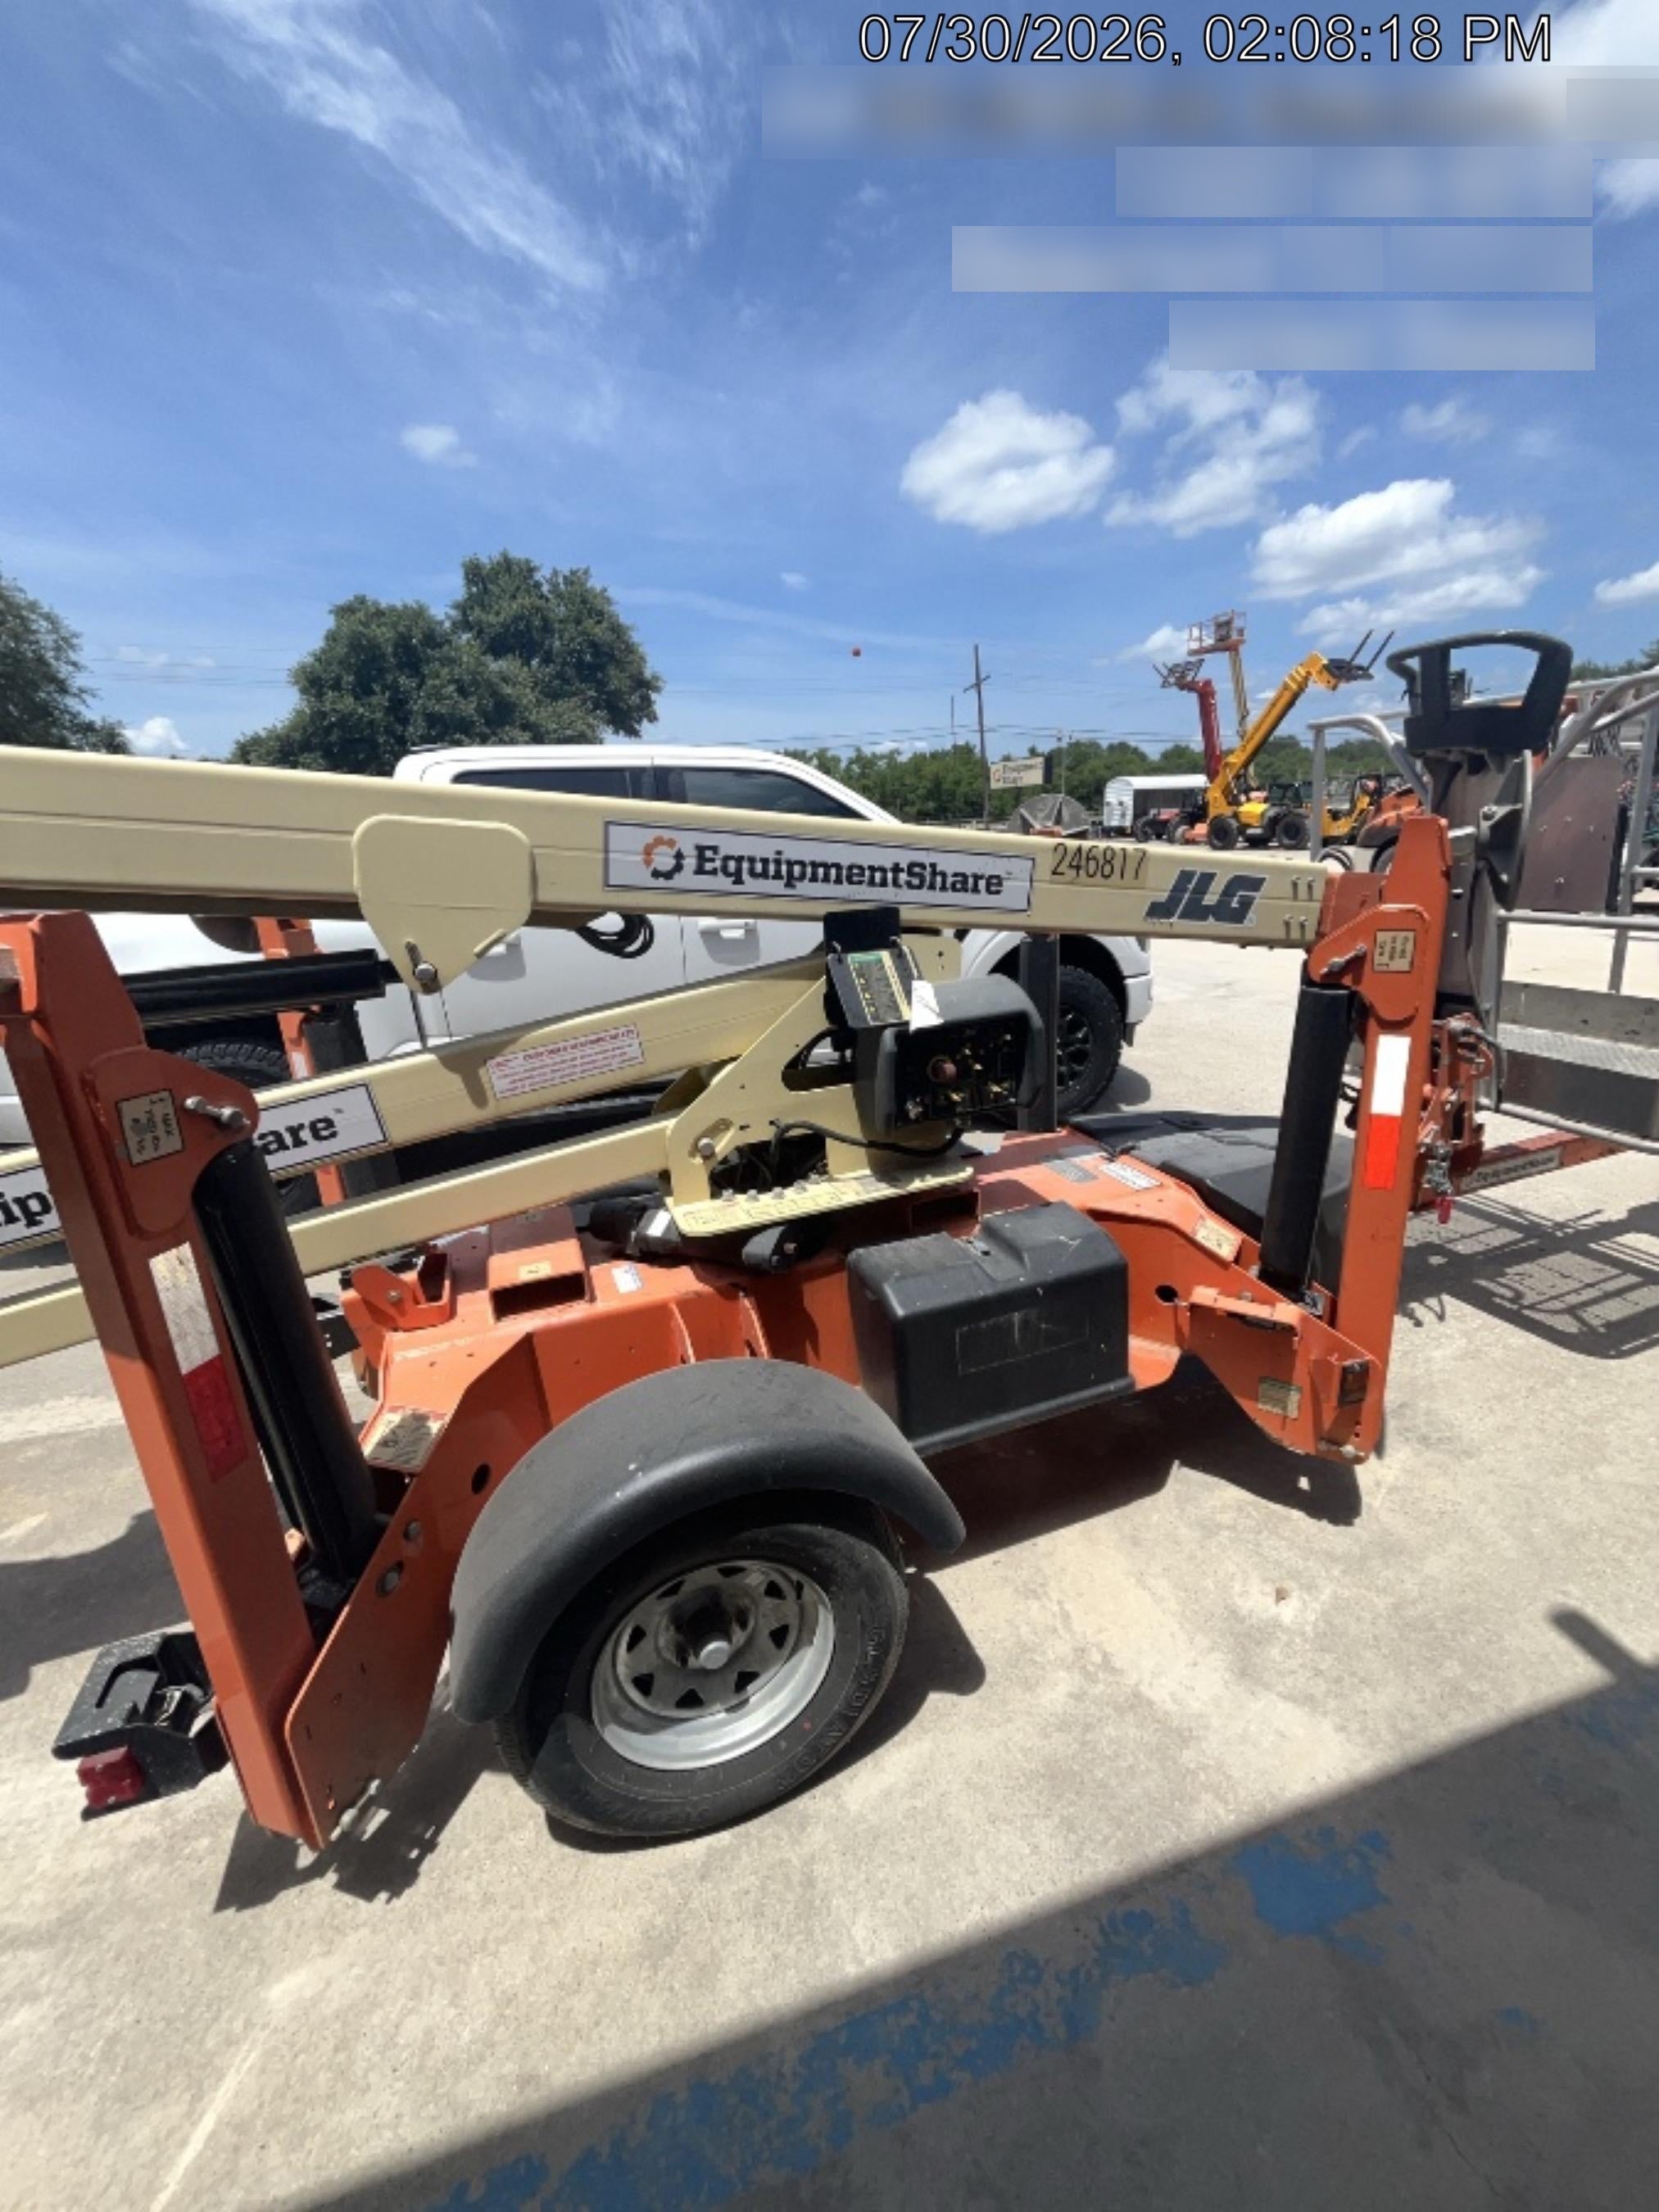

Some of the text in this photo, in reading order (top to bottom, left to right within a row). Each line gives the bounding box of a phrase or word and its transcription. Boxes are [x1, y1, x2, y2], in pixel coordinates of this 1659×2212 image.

[693, 845, 1004, 895] EquipmentShare
[1051, 843, 1147, 881] 246817
[1144, 868, 1267, 925] JLG
[257, 1115, 339, 1156] are
